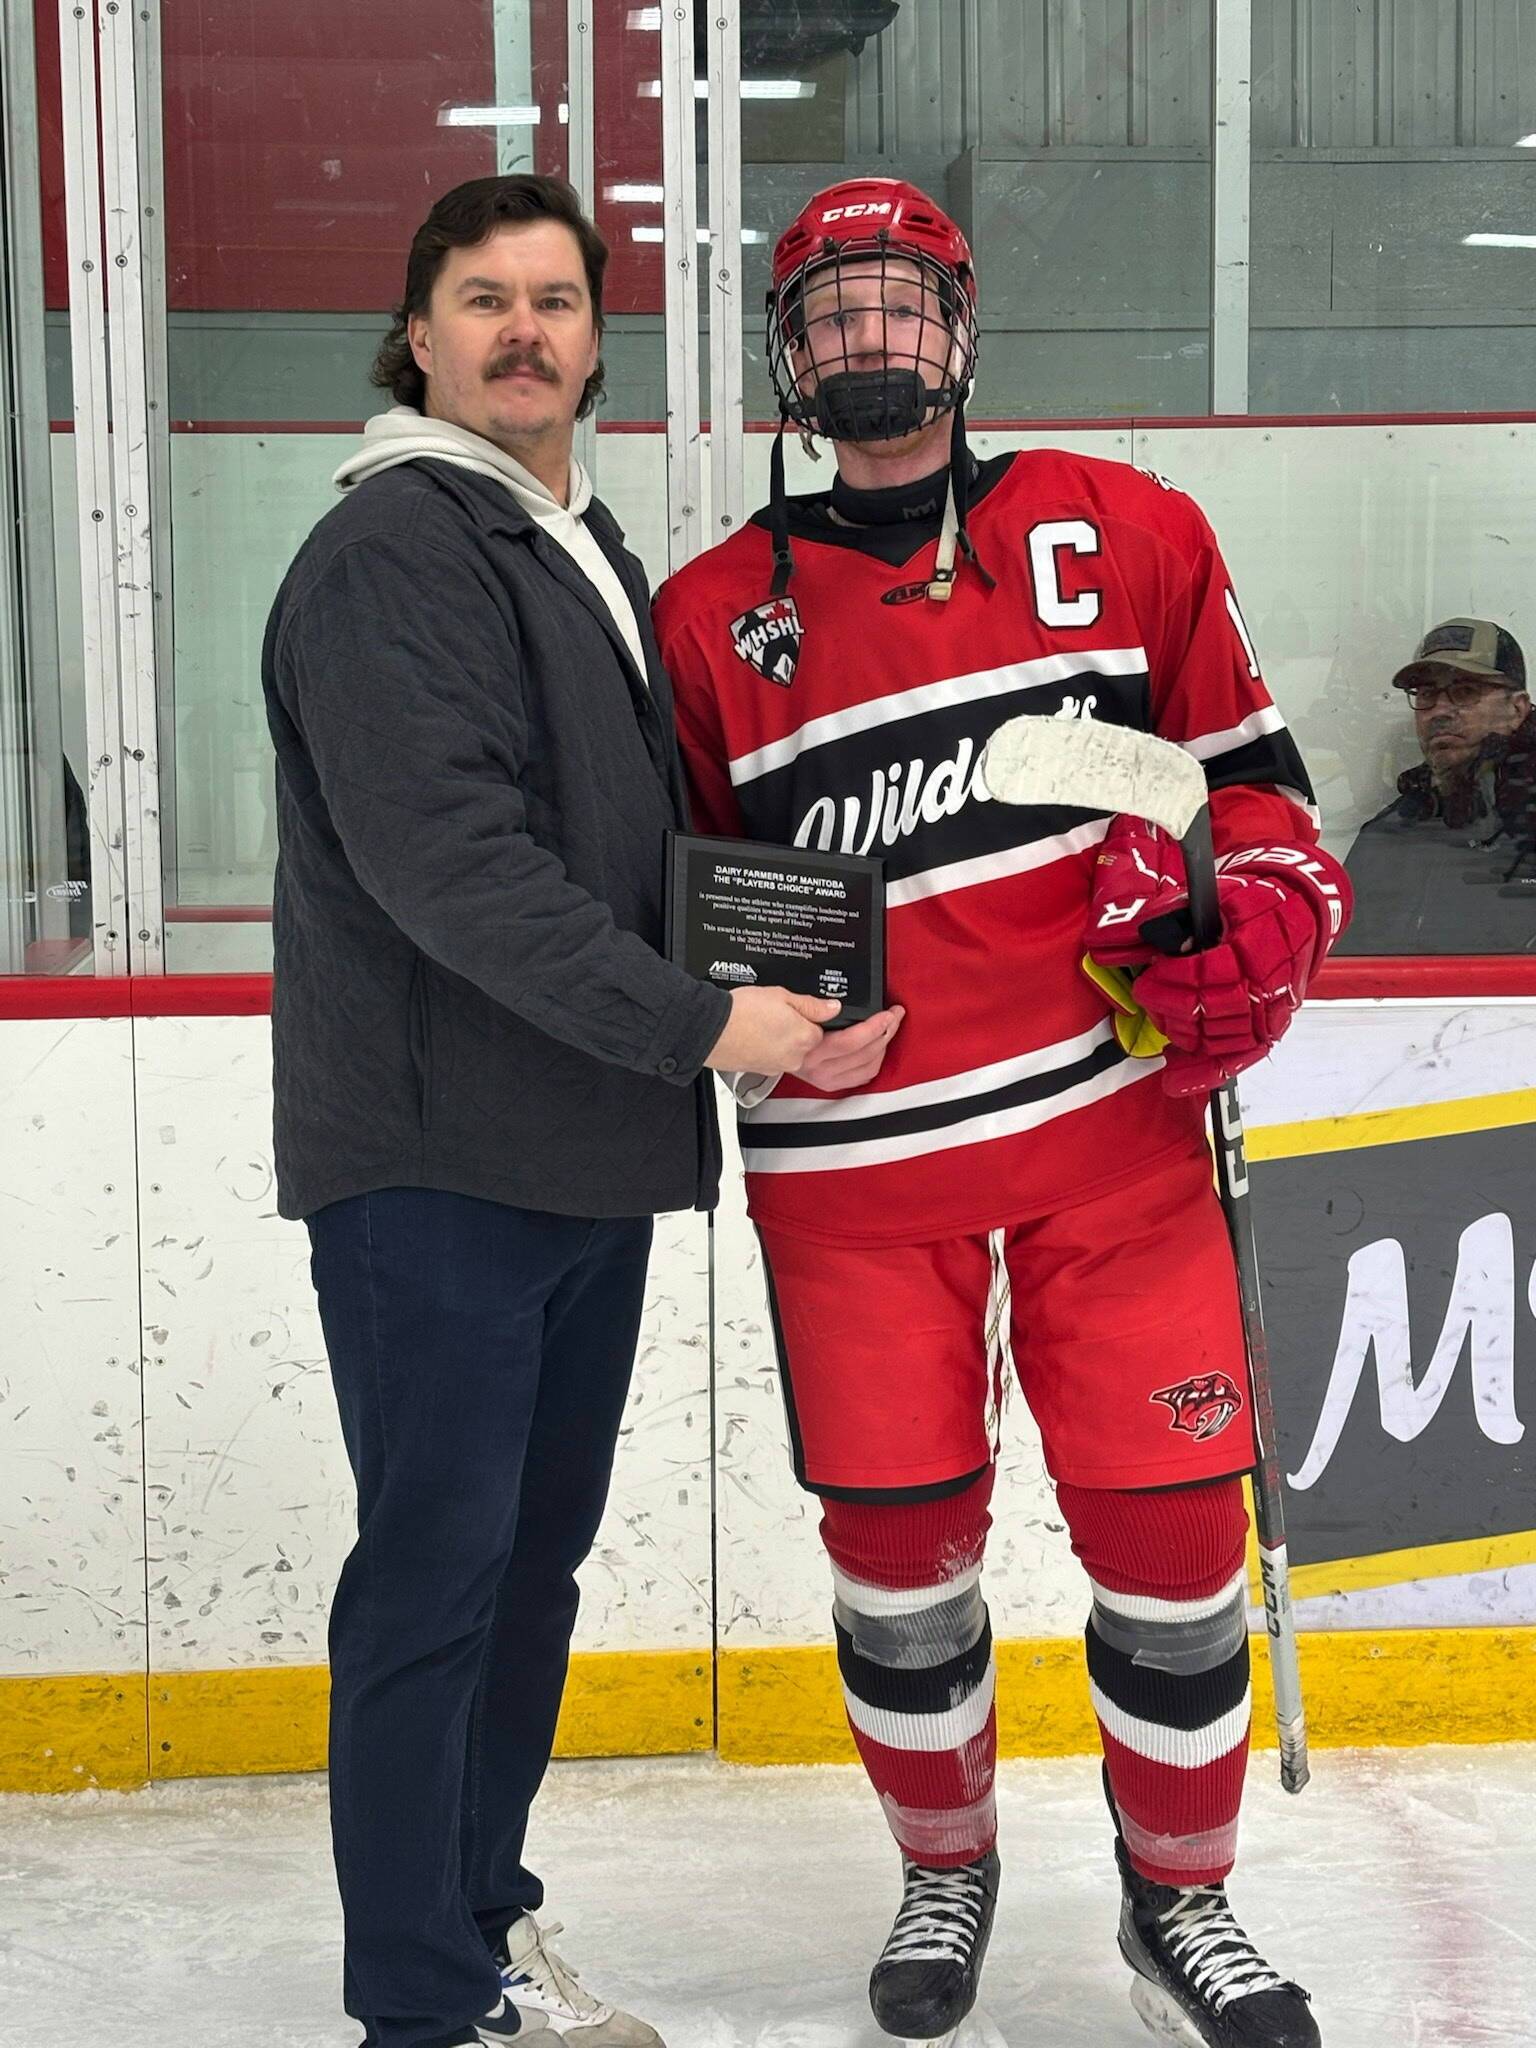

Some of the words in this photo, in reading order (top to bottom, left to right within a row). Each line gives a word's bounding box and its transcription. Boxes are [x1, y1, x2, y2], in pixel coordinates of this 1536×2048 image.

[821, 202, 892, 223] CCM
[1029, 520, 1101, 629] C
[734, 616, 805, 660] WHSHL
[713, 874, 731, 885] THE
[732, 877, 775, 890] "PLAYERS
[777, 883, 814, 894] CHOICE"
[815, 887, 847, 899] AWARD
[715, 865, 742, 876] DAIRY
[743, 869, 784, 882] FARMERS
[786, 874, 798, 883] OF
[800, 876, 845, 889] MANITOBA
[705, 893, 733, 902] presented
[751, 898, 771, 907] athlete
[772, 900, 784, 908] who
[819, 906, 848, 917] leadership
[713, 902, 736, 910] positive
[737, 904, 761, 913] qualities
[762, 907, 785, 917] towards
[785, 910, 799, 918] their
[702, 922, 717, 931] This
[717, 926, 735, 934] award
[742, 928, 762, 937] chosen
[763, 930, 771, 939] by
[772, 931, 790, 940] fellow
[814, 937, 827, 945] who
[768, 916, 782, 924] sport
[791, 918, 814, 929] Hockey
[729, 934, 736, 942] in
[737, 935, 746, 943] the
[763, 938, 792, 949] Provincial
[793, 942, 808, 951] High
[808, 943, 829, 953] School
[745, 943, 767, 954] Hockey
[768, 947, 813, 959] Championships
[708, 960, 758, 978] MHSAA
[1286, 1211, 1536, 1491] M
[1260, 1556, 1281, 1639] CCM
